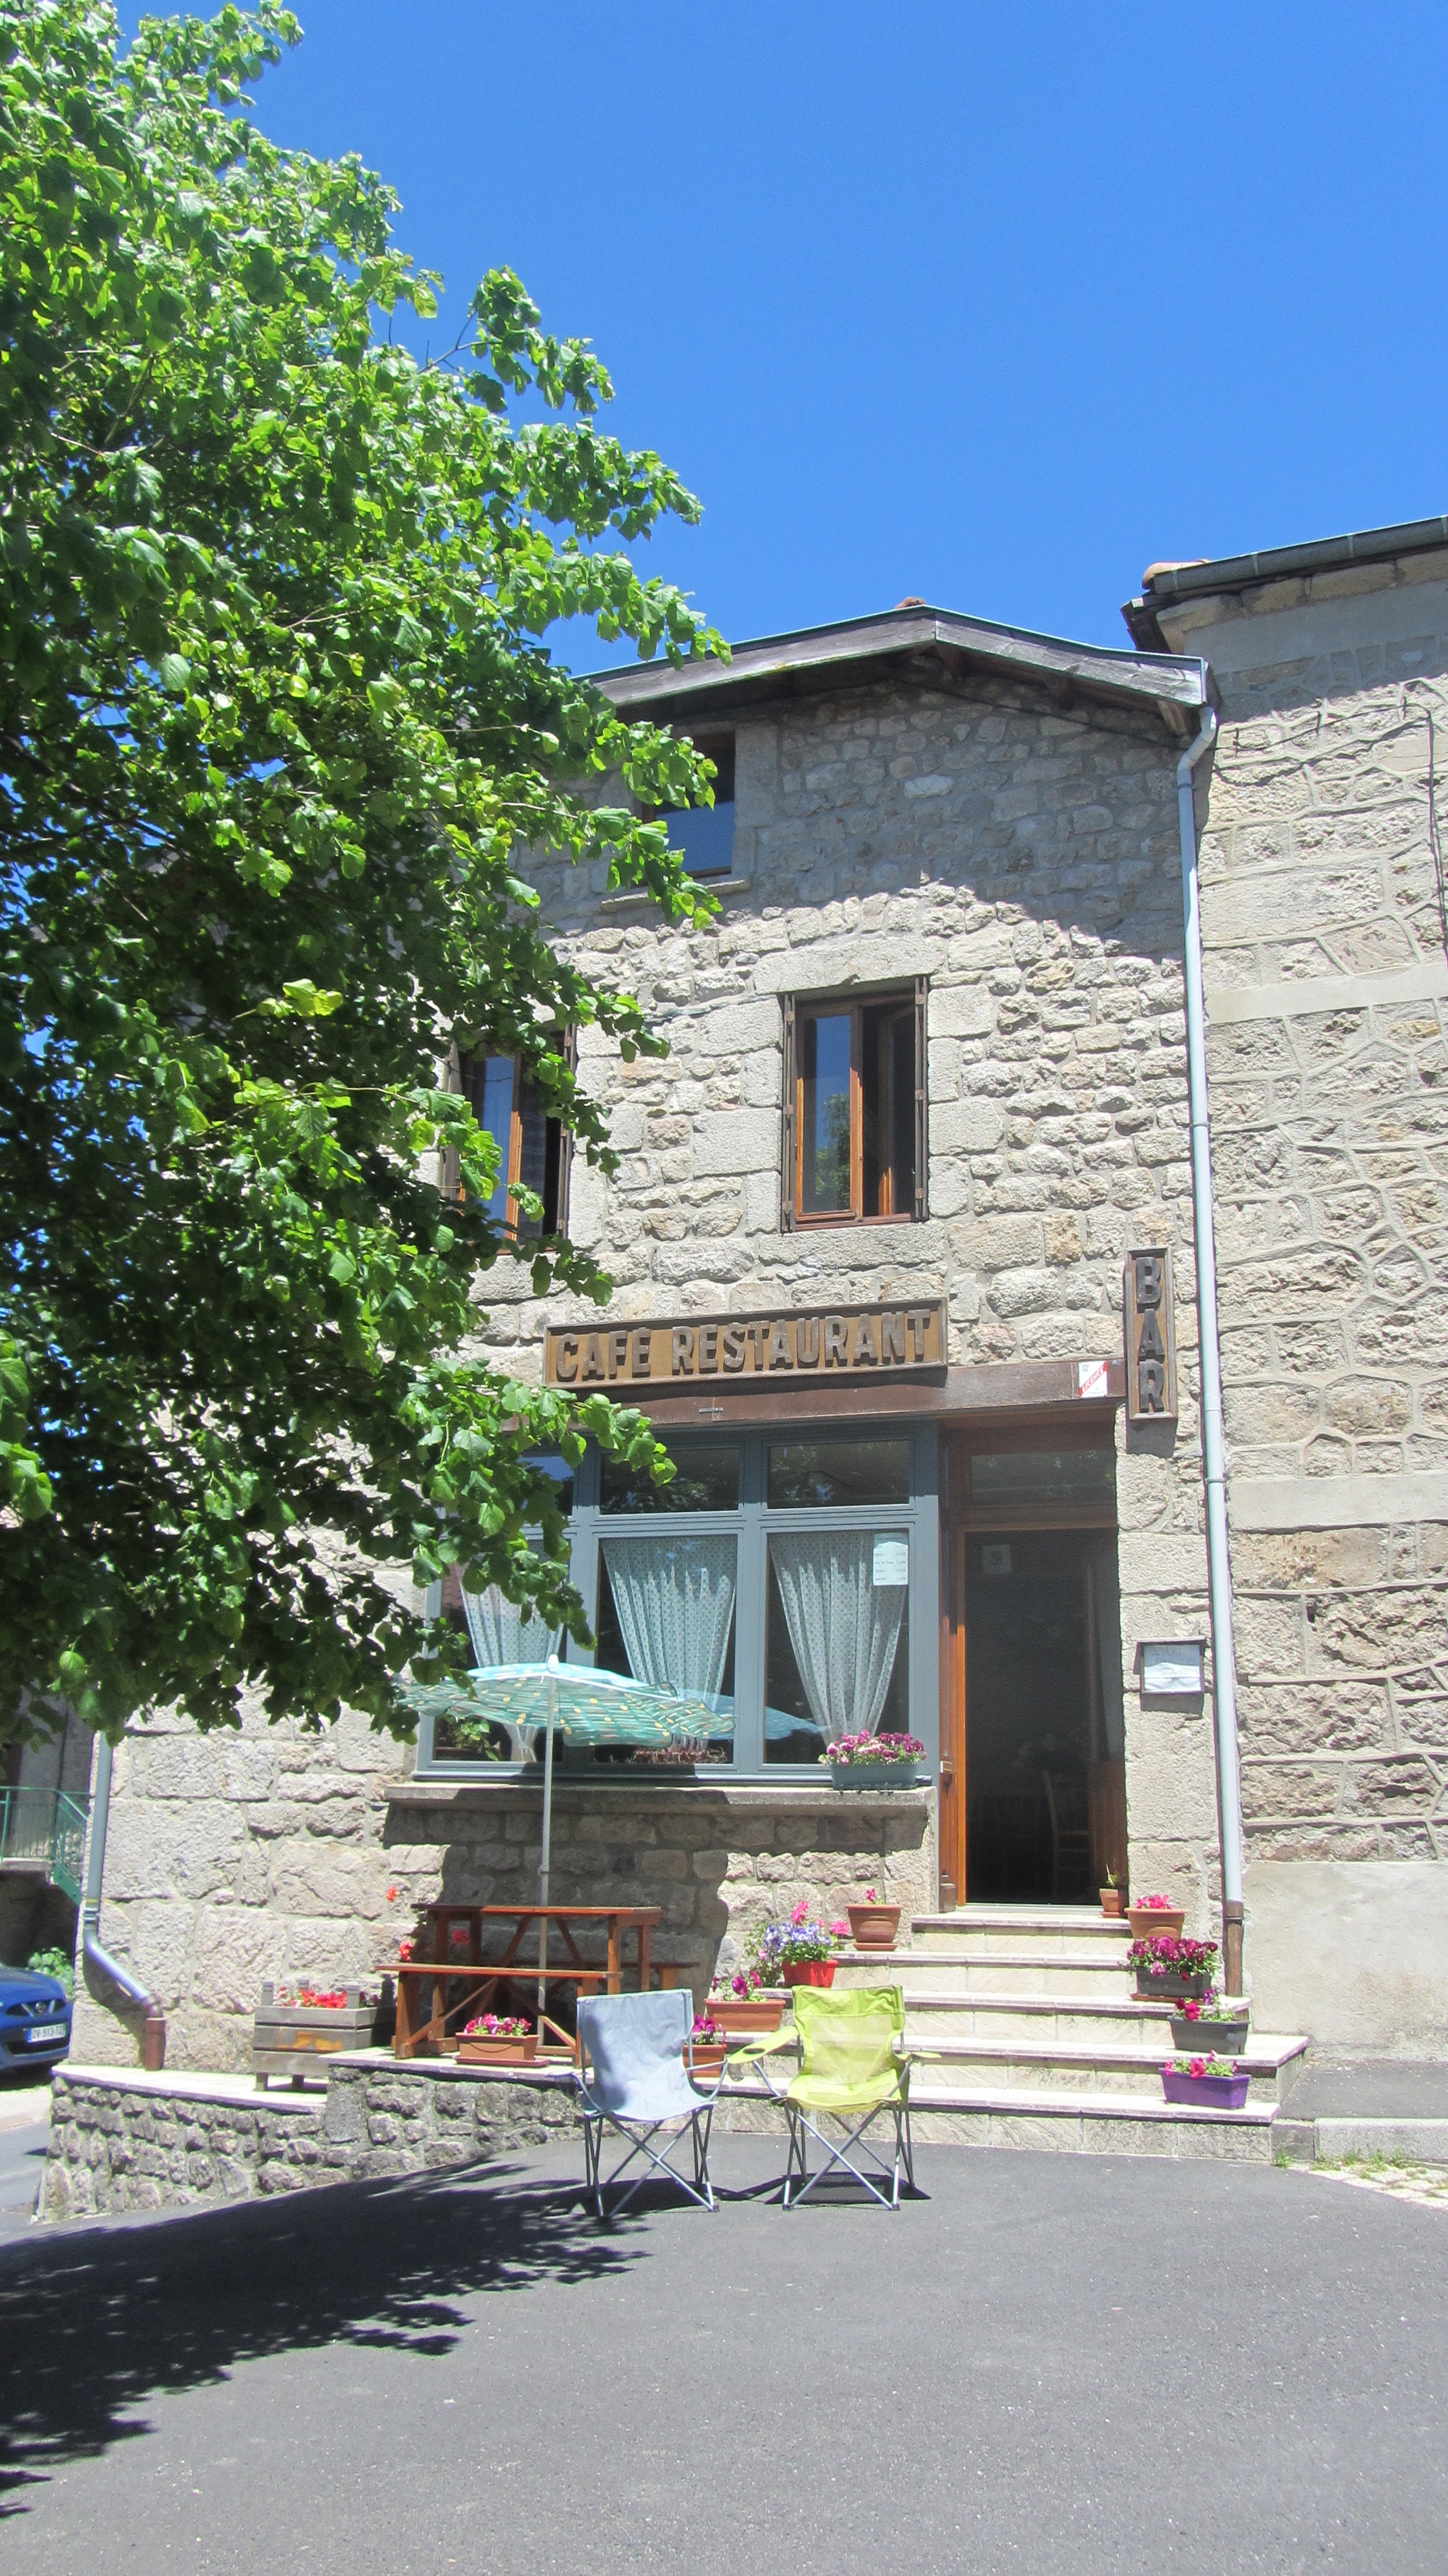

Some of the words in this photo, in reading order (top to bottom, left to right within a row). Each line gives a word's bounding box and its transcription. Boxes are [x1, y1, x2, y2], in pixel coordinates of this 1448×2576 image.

[555, 1327, 651, 1381] CAFE
[671, 1309, 931, 1374] RESTAURANT
[1136, 1256, 1165, 1412] BAR
[1081, 1365, 1106, 1394] LICENCE
